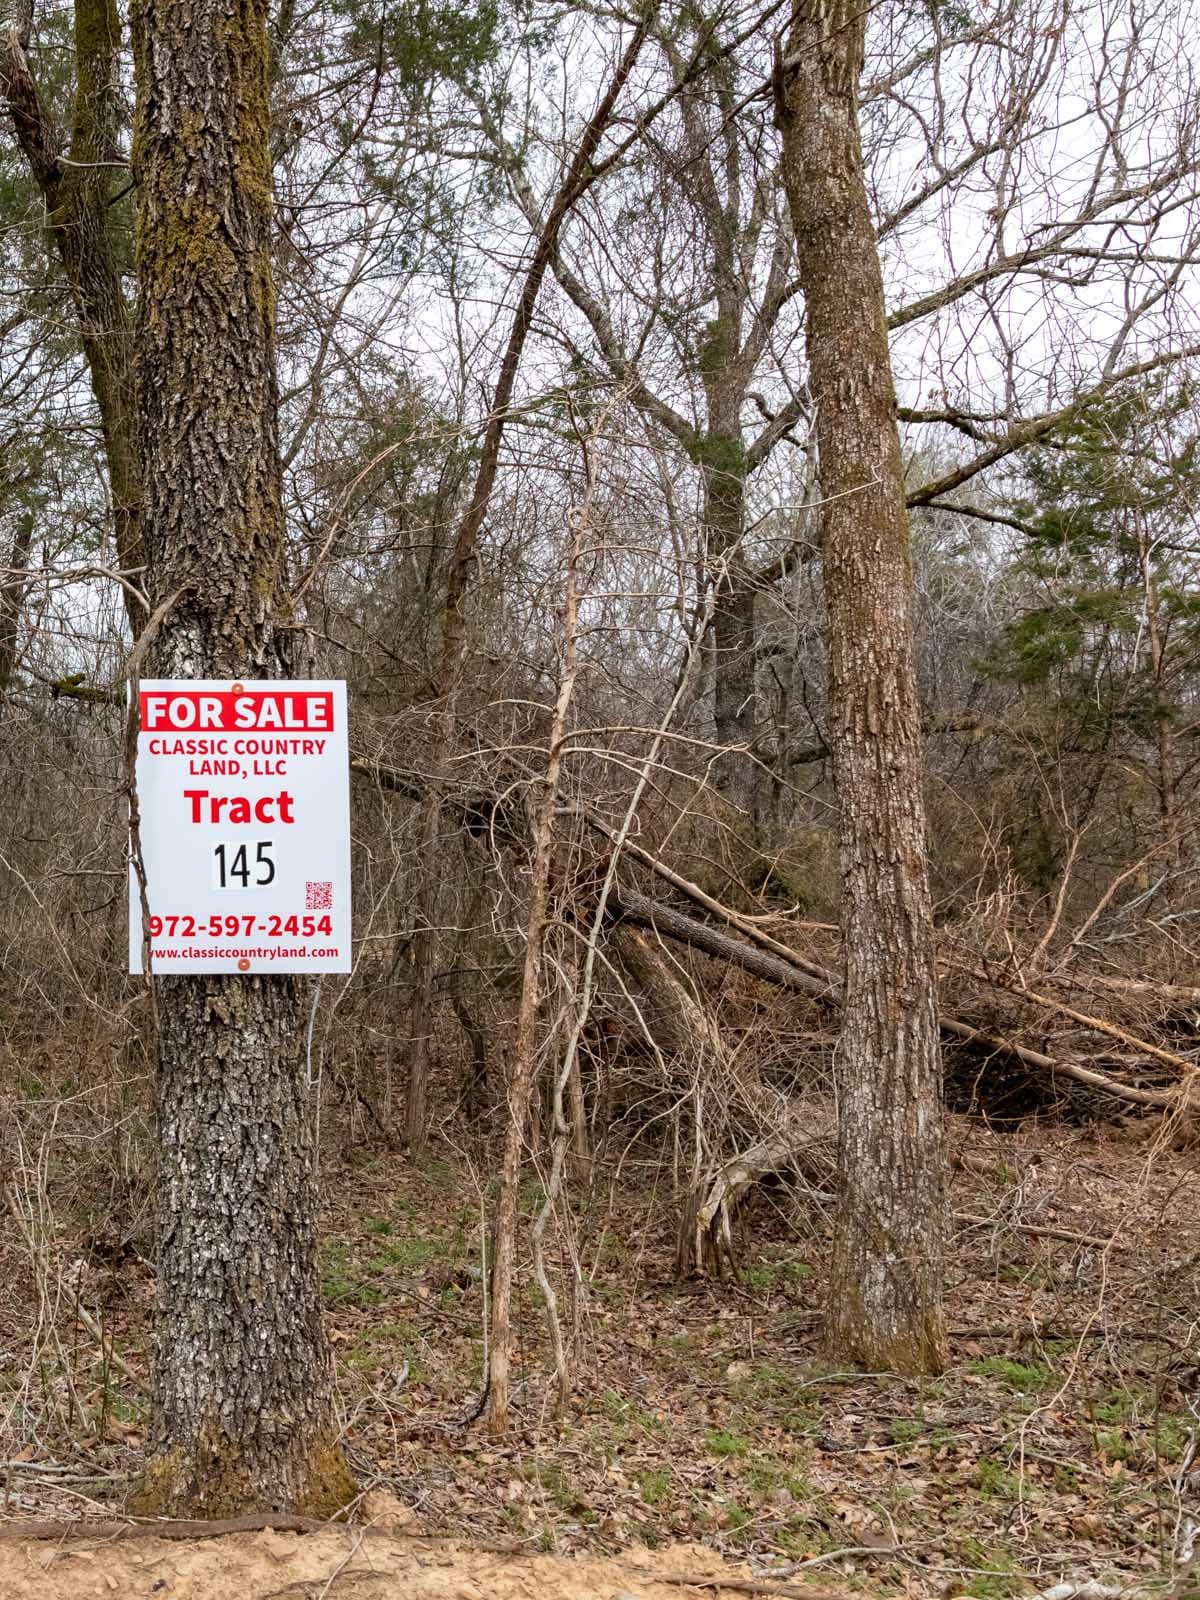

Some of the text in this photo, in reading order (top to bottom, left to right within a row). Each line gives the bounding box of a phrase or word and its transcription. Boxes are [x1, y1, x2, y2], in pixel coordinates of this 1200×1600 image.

[147, 697, 327, 728] FOR SALE
[149, 739, 326, 755] CLASSIC COUNTRY
[189, 760, 287, 779] LAND, LLC
[184, 790, 295, 824] Tract
[214, 841, 275, 888] 145
[150, 915, 333, 937] 972-597-2454
